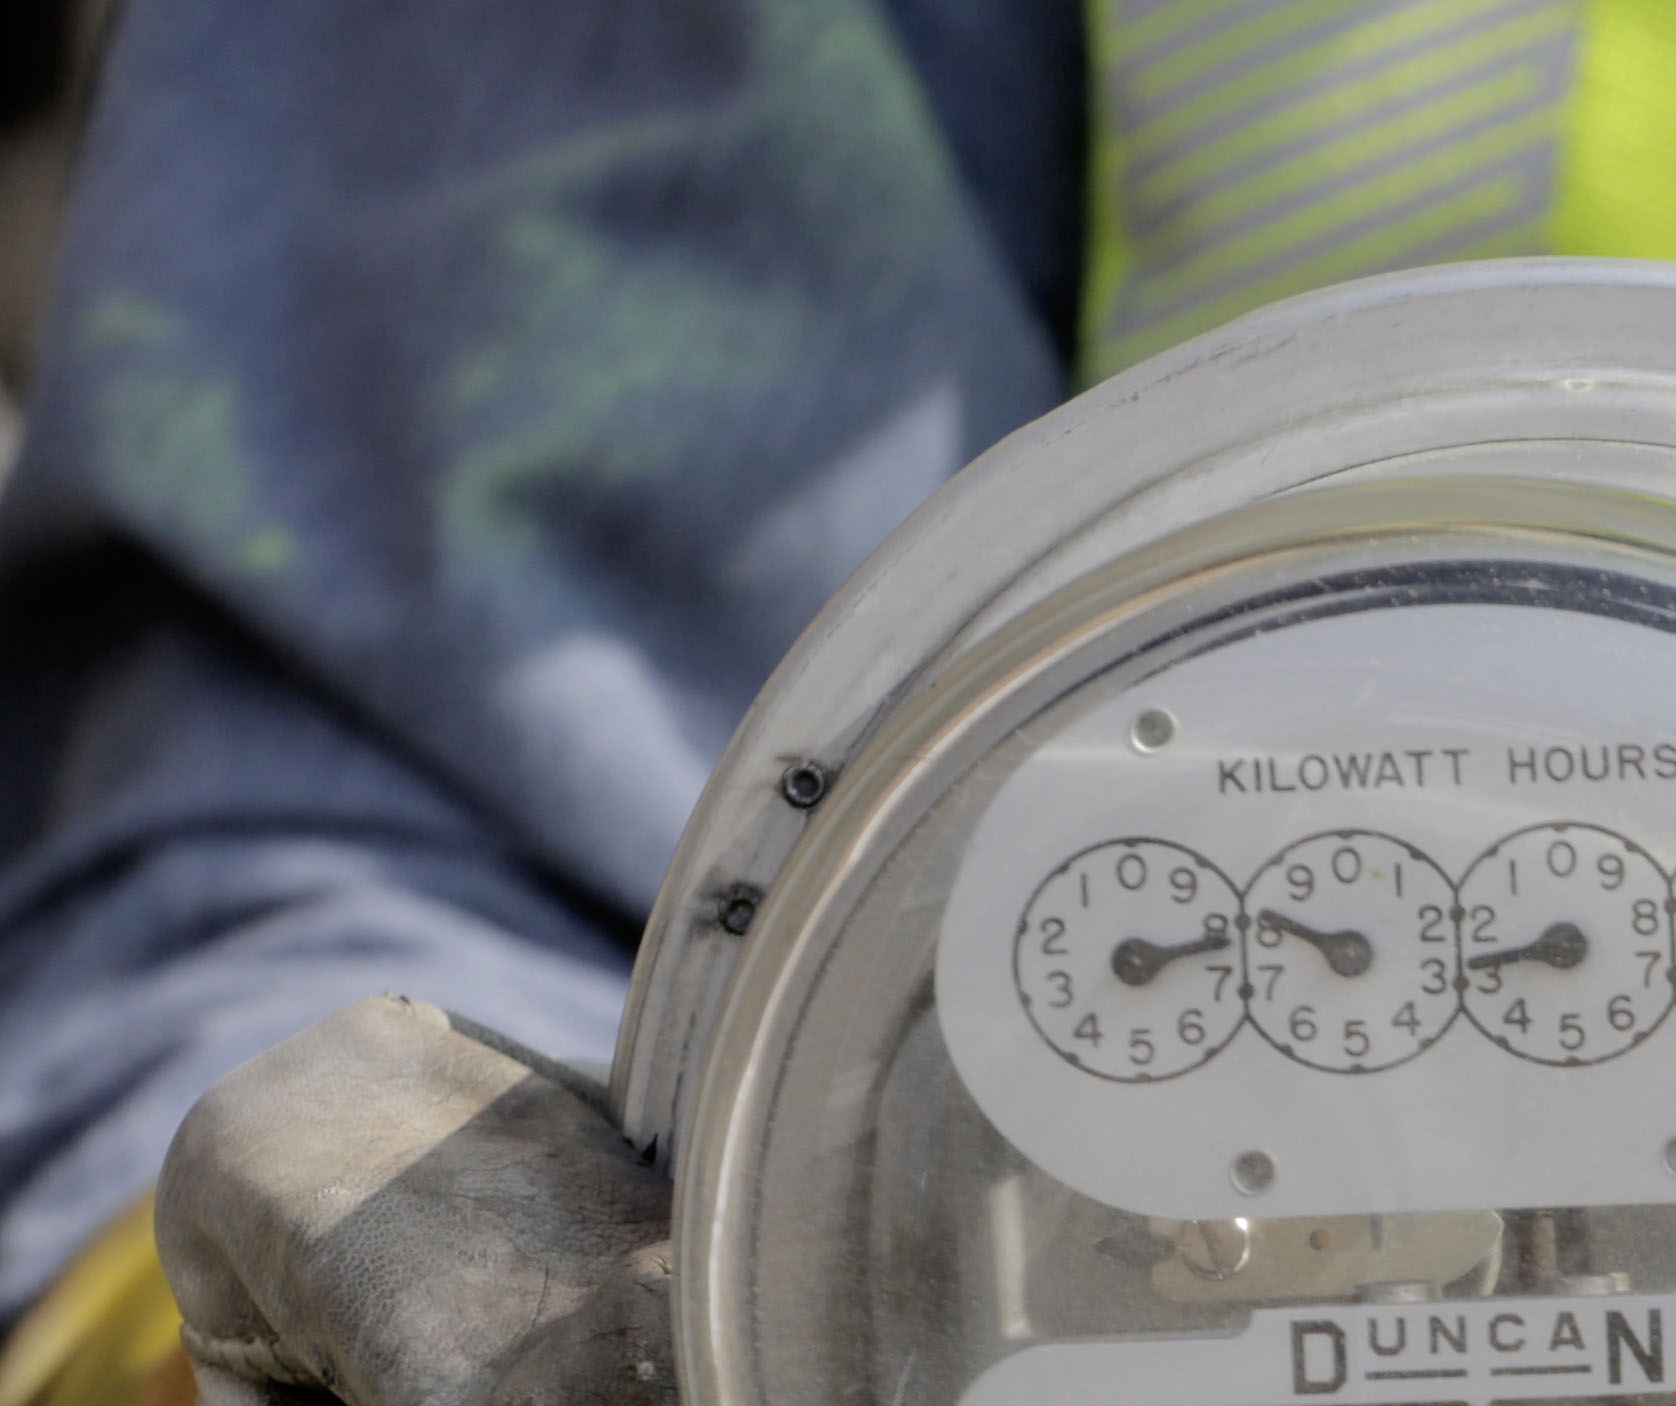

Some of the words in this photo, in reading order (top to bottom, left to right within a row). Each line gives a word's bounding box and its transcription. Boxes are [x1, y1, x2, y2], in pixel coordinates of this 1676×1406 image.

[1217, 748, 1470, 796] KILOWATT
[1115, 853, 1148, 890] 0
[1331, 847, 1362, 884] 0
[1546, 840, 1577, 877] 0
[1597, 853, 1625, 890] 9
[1169, 867, 1198, 904] 9
[1286, 864, 1315, 902] 9
[1040, 917, 1069, 954] 2
[1418, 905, 1446, 942] 2
[1470, 905, 1498, 942] 2
[1632, 899, 1659, 936] 8
[1205, 965, 1233, 1002] 7
[1257, 964, 1285, 1001] 7
[1420, 958, 1447, 995] 3
[1635, 950, 1661, 987] 7
[1047, 970, 1074, 1008] 3
[1074, 1012, 1103, 1048] 4
[1178, 1008, 1206, 1046] 6
[1289, 1006, 1317, 1042] 6
[1391, 1000, 1421, 1036] 4
[1503, 998, 1532, 1034] 4
[1559, 1013, 1586, 1050] 5
[1607, 995, 1635, 1032] 6
[1129, 1028, 1155, 1066] 5
[1343, 1020, 1370, 1057] 5
[1289, 1309, 1664, 1396] DUNCAN
